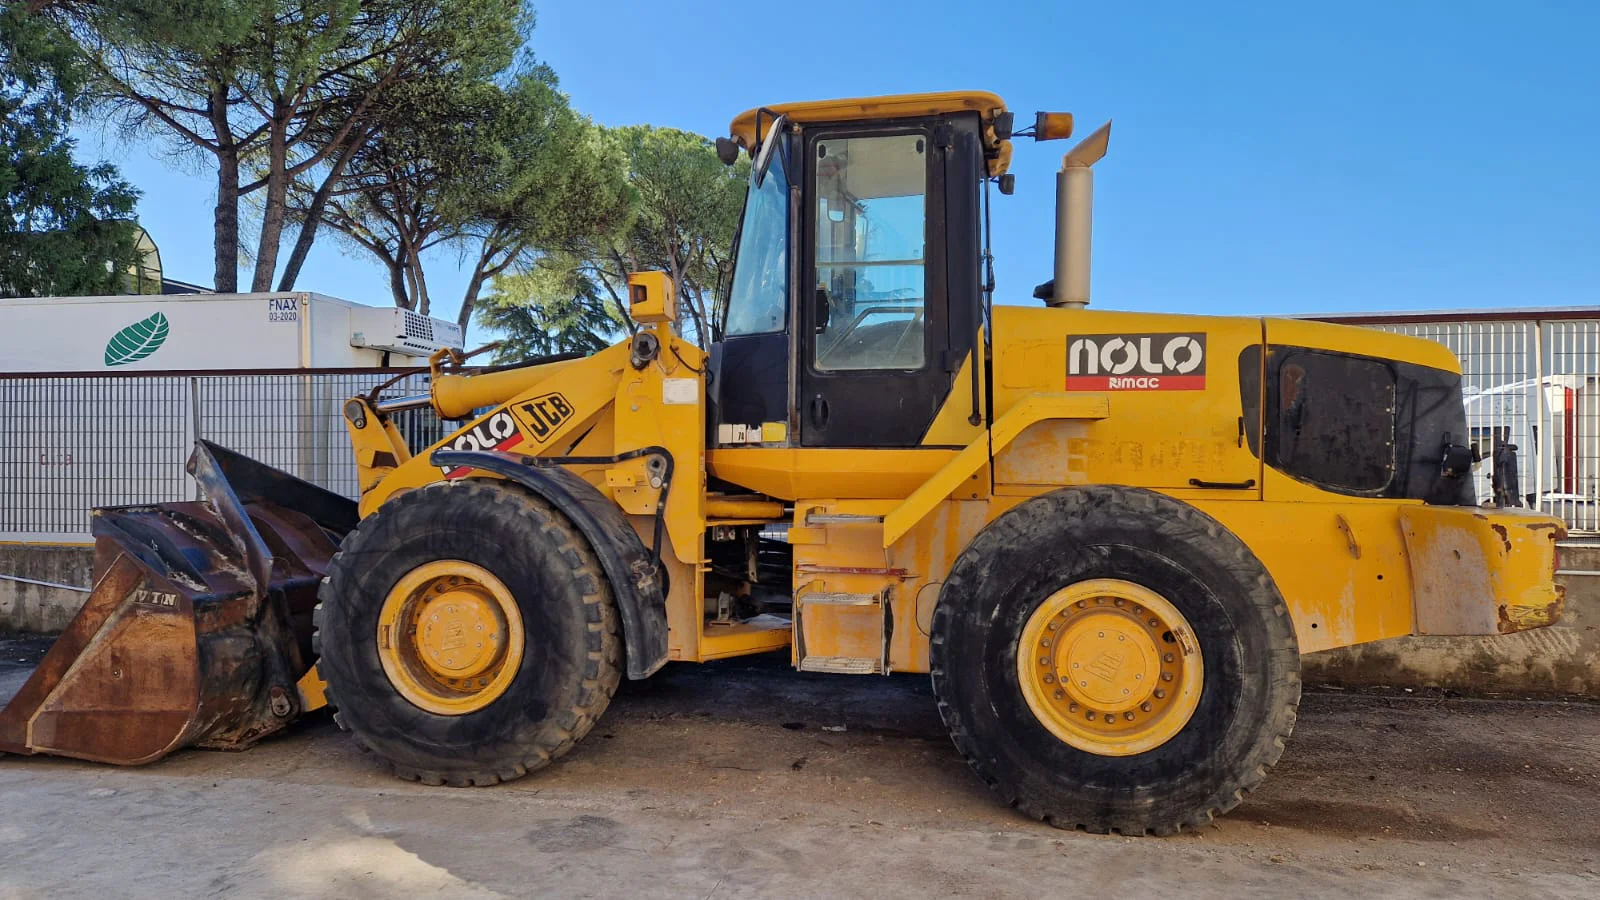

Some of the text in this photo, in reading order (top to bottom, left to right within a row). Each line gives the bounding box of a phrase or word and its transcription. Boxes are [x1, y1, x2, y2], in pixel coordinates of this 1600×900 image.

[269, 299, 297, 311] FNAX
[269, 312, 297, 321] 03-2020
[1109, 377, 1160, 389] Rimac
[521, 396, 571, 437] JCB
